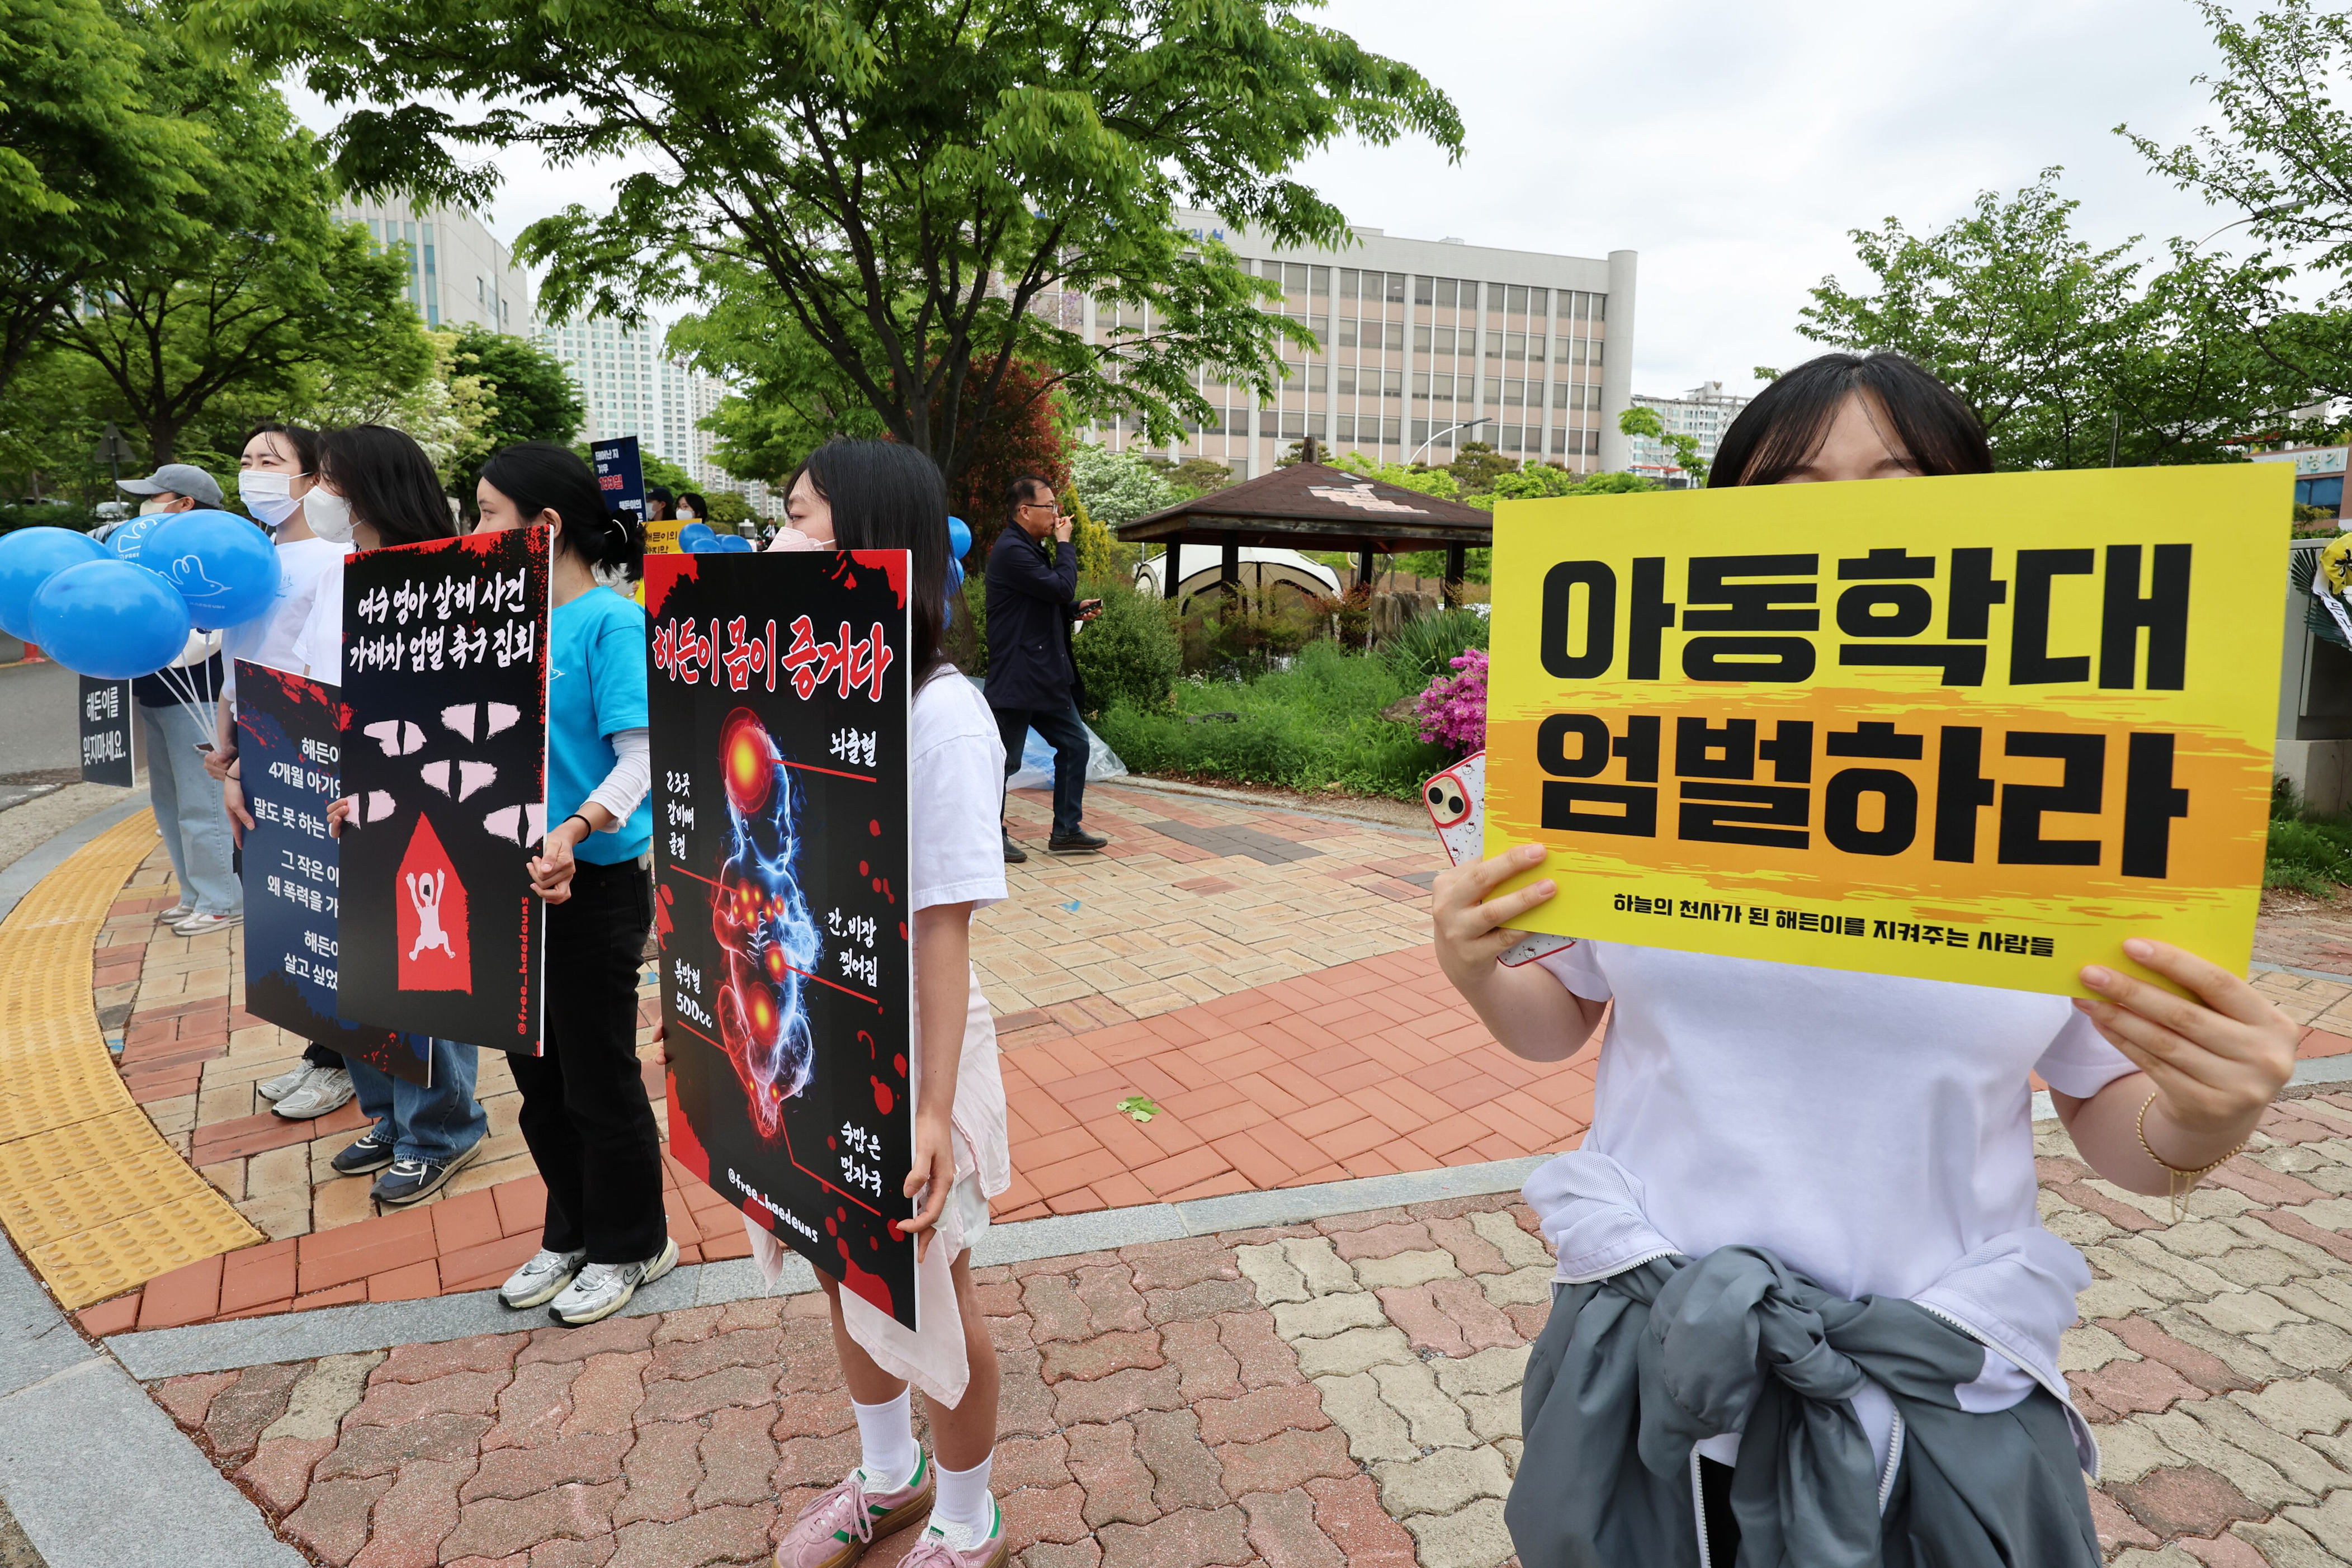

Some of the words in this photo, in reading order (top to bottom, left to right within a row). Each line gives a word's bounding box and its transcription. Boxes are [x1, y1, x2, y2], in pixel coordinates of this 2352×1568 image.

[598, 474, 624, 490] 133일
[358, 586, 389, 625] 여수
[393, 579, 428, 625] 영아
[432, 575, 476, 620] 살해
[480, 567, 526, 613] 사건
[1539, 544, 2193, 691] 아동학대
[350, 632, 405, 673] 가해자
[409, 625, 445, 672] 엄벌
[448, 624, 488, 669] 촉구
[492, 618, 535, 668] 집회
[651, 617, 719, 687] 해든이
[722, 615, 776, 693] 몸이
[781, 614, 894, 702] 증거다
[87, 686, 119, 721] 해든이를
[83, 730, 126, 766] 잊지마세요.
[301, 738, 340, 764] 해든이
[829, 728, 877, 768] 뇌출혈
[268, 762, 304, 788] 4개월
[666, 771, 691, 798] 23곳
[667, 799, 695, 831] 갈비뼈
[1536, 712, 2189, 880] 엄벌하라
[254, 797, 280, 823] 말도
[282, 806, 295, 829] 못
[297, 813, 325, 839] 하는
[281, 849, 294, 870] 그
[297, 853, 324, 882] 작은
[668, 831, 686, 860] 골절
[267, 875, 280, 897] 왜
[283, 880, 322, 912] 폭력을
[326, 896, 338, 918] 가
[1614, 893, 1673, 916] 하늘의
[1680, 900, 1742, 923] 천사가
[1748, 906, 1769, 927] 된
[1775, 909, 1865, 937] 해든이를
[1873, 919, 1968, 948] 지켜주는
[1977, 931, 2054, 957] 사람들
[284, 952, 309, 978] 살고
[313, 964, 338, 990] 싶었
[518, 898, 528, 1035] @free_haedeuns
[674, 958, 701, 994] 복막혈
[839, 948, 877, 988] 찢어짐
[676, 990, 712, 1028] 500cc
[840, 1121, 881, 1161] 수많은
[840, 1154, 882, 1198] 멍자국
[728, 1167, 819, 1243] @free_haedeuns
